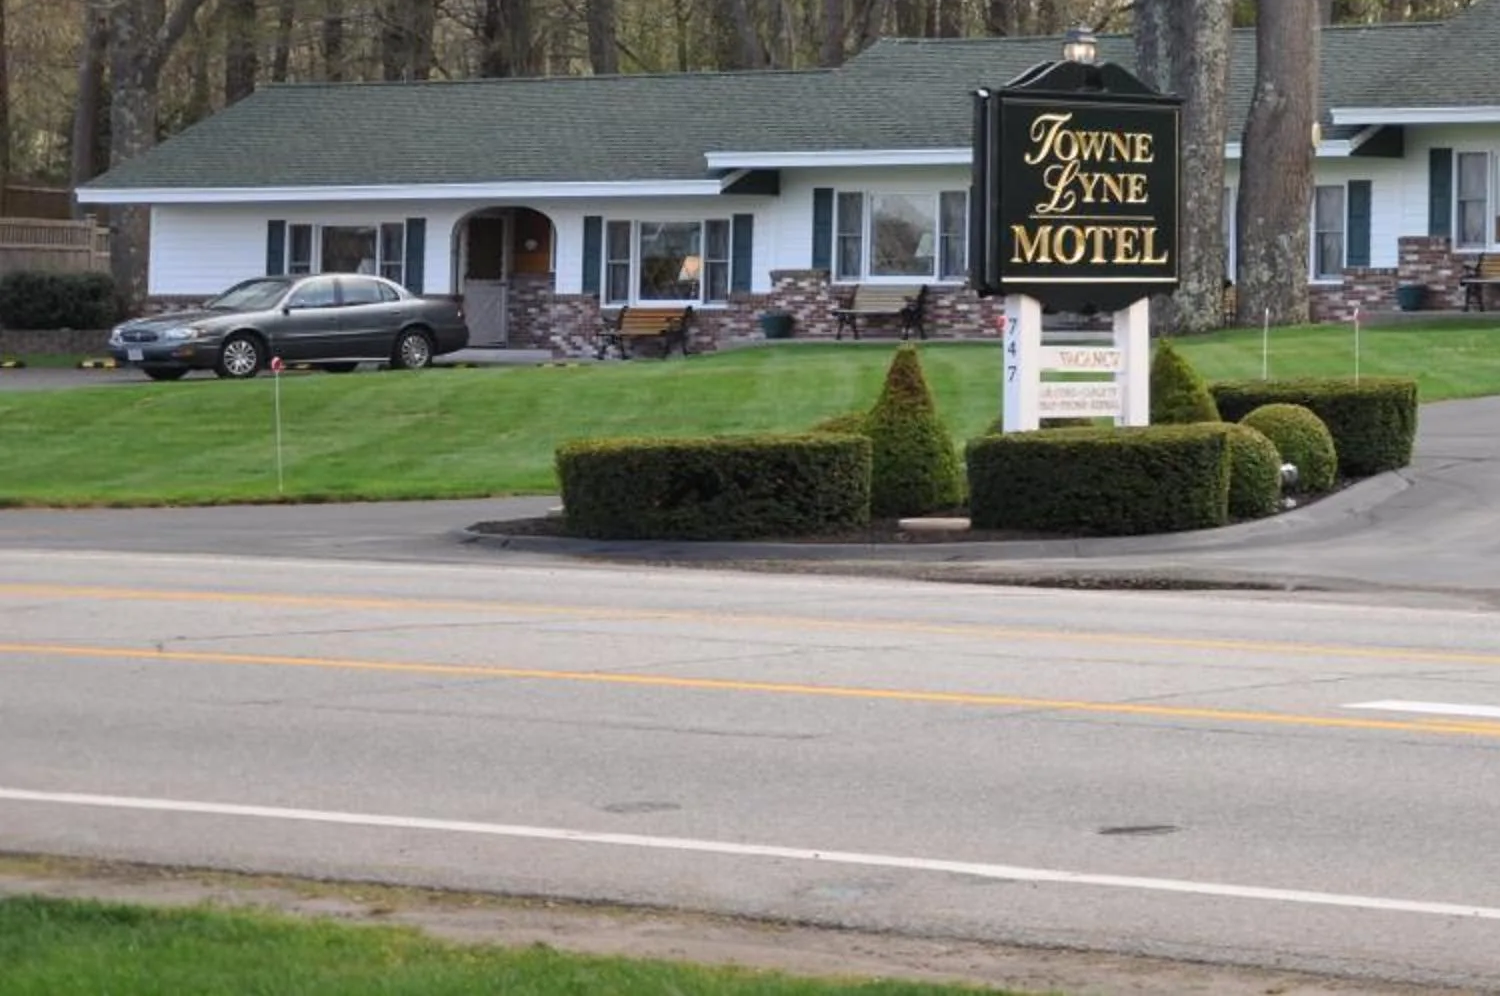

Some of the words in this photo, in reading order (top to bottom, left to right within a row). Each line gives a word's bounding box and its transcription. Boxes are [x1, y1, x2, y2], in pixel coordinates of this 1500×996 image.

[1024, 112, 1154, 165] TOWNE
[1036, 160, 1149, 214] LYNE
[1011, 226, 1168, 264] MOTEL
[1007, 318, 1018, 382] 747
